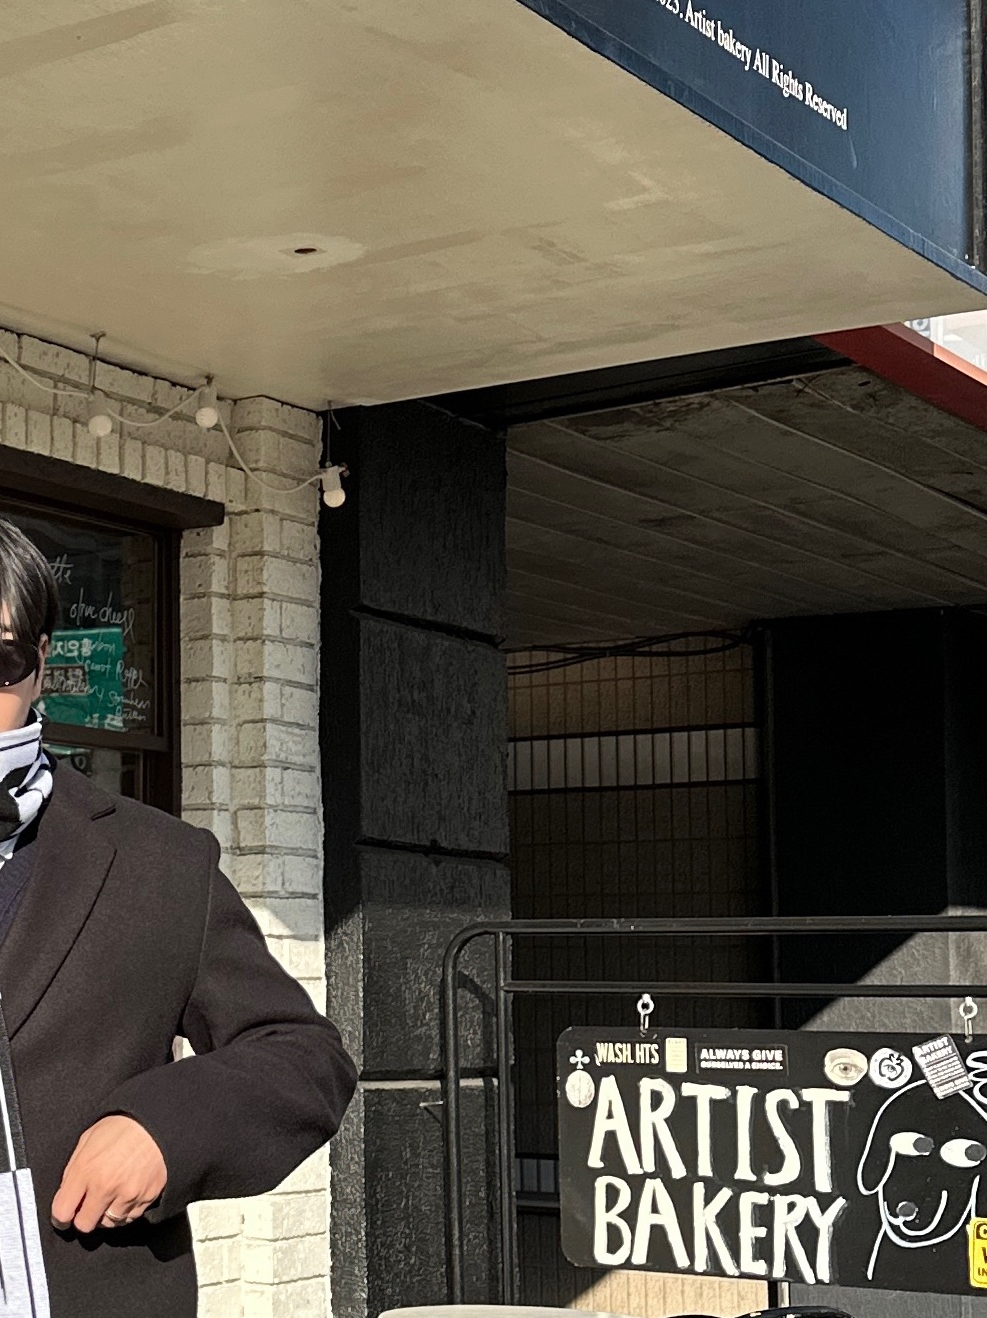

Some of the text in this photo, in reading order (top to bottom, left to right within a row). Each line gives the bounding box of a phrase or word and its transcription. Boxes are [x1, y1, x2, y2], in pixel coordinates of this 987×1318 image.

[684, 0, 716, 41] Artist
[717, 20, 752, 71] bakery
[753, 48, 769, 79] All
[771, 58, 803, 98] Rights
[805, 81, 848, 130] Reserved
[700, 1048, 750, 1061] ALWAYS
[752, 1049, 783, 1062] GIVE
[587, 1074, 851, 1193] ARTIST
[593, 1175, 848, 1284] BAKERY
